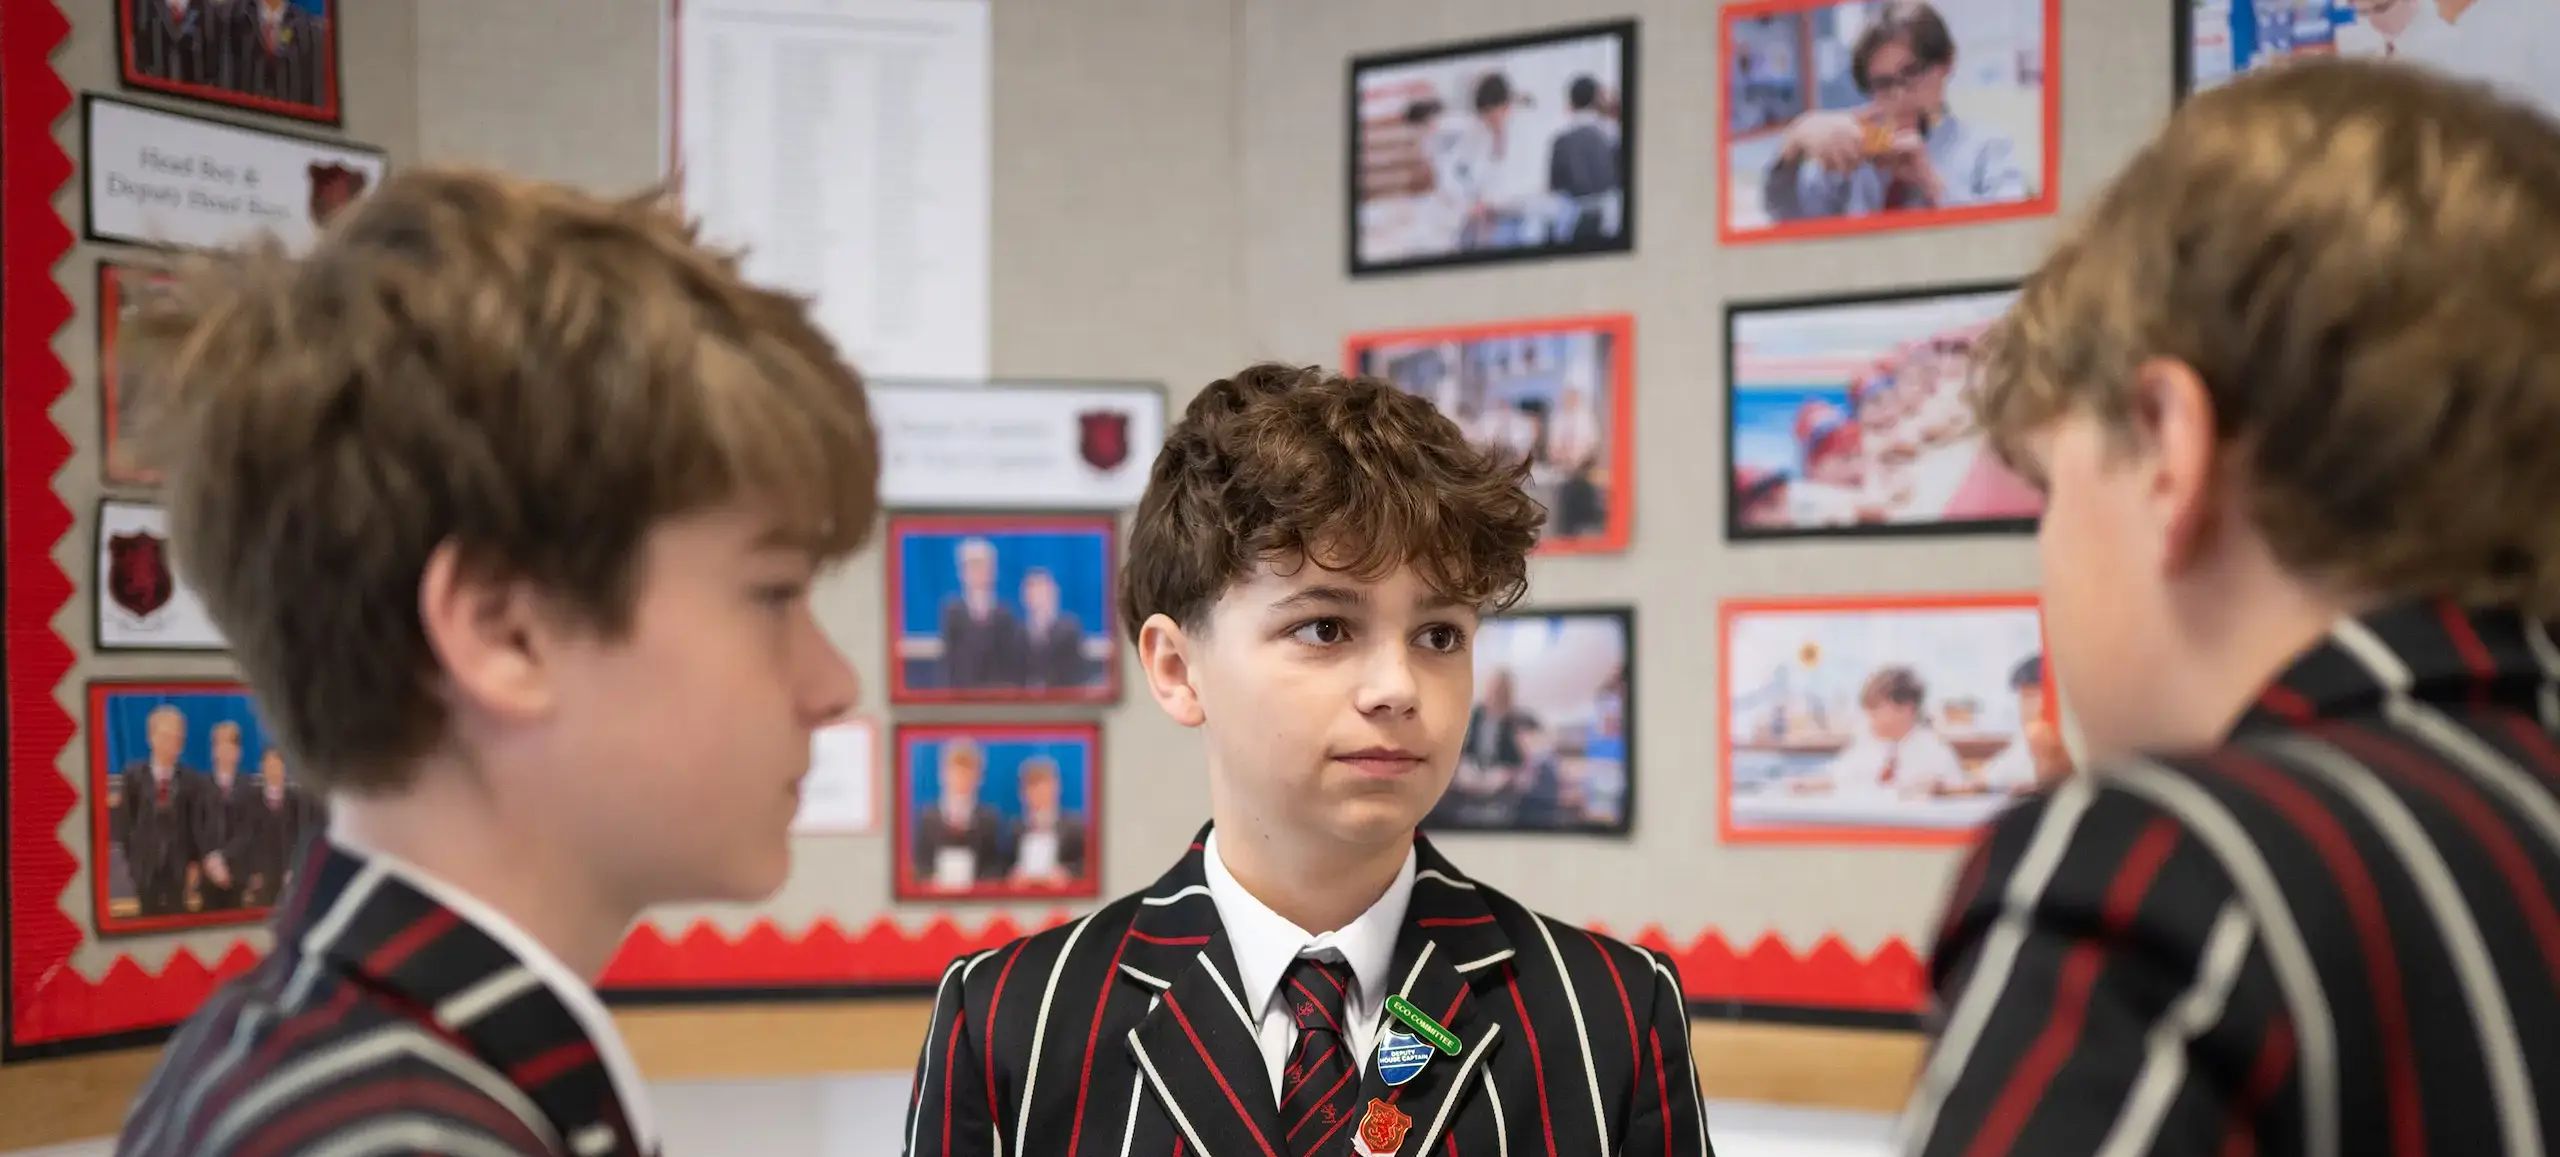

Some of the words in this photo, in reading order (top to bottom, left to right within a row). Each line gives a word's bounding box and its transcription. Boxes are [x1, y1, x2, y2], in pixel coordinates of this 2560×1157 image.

[1393, 1001, 1411, 1016] ECO
[1411, 1015, 1455, 1048] COMMITTEE
[1391, 1049, 1415, 1057] DEPUTY
[1380, 1056, 1401, 1064] HOUSE
[1402, 1054, 1428, 1062] CAPTAIN
